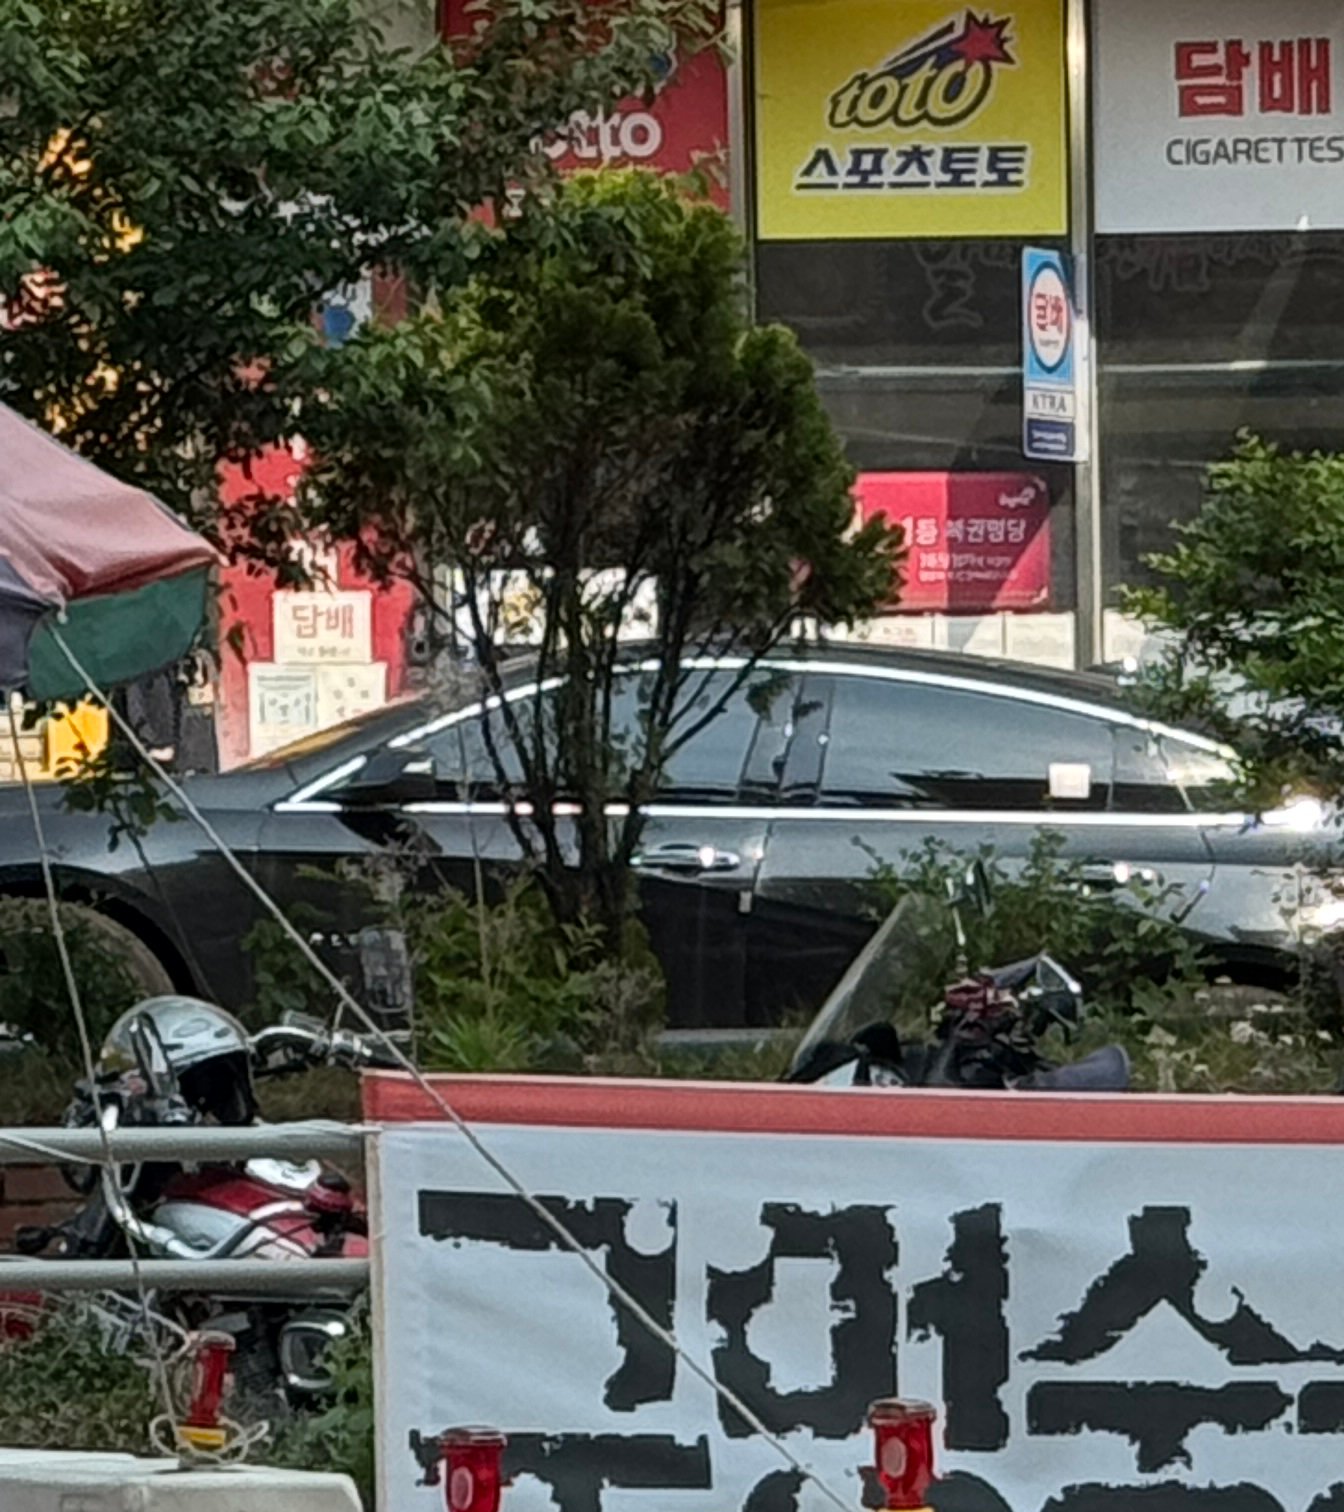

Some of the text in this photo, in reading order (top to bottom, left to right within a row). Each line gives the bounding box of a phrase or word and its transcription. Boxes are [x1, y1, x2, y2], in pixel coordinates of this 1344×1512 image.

[828, 53, 993, 127] toto
[1174, 37, 1332, 118] 담배
[795, 144, 1029, 190] 스포츠토토
[292, 603, 354, 639] 담배
